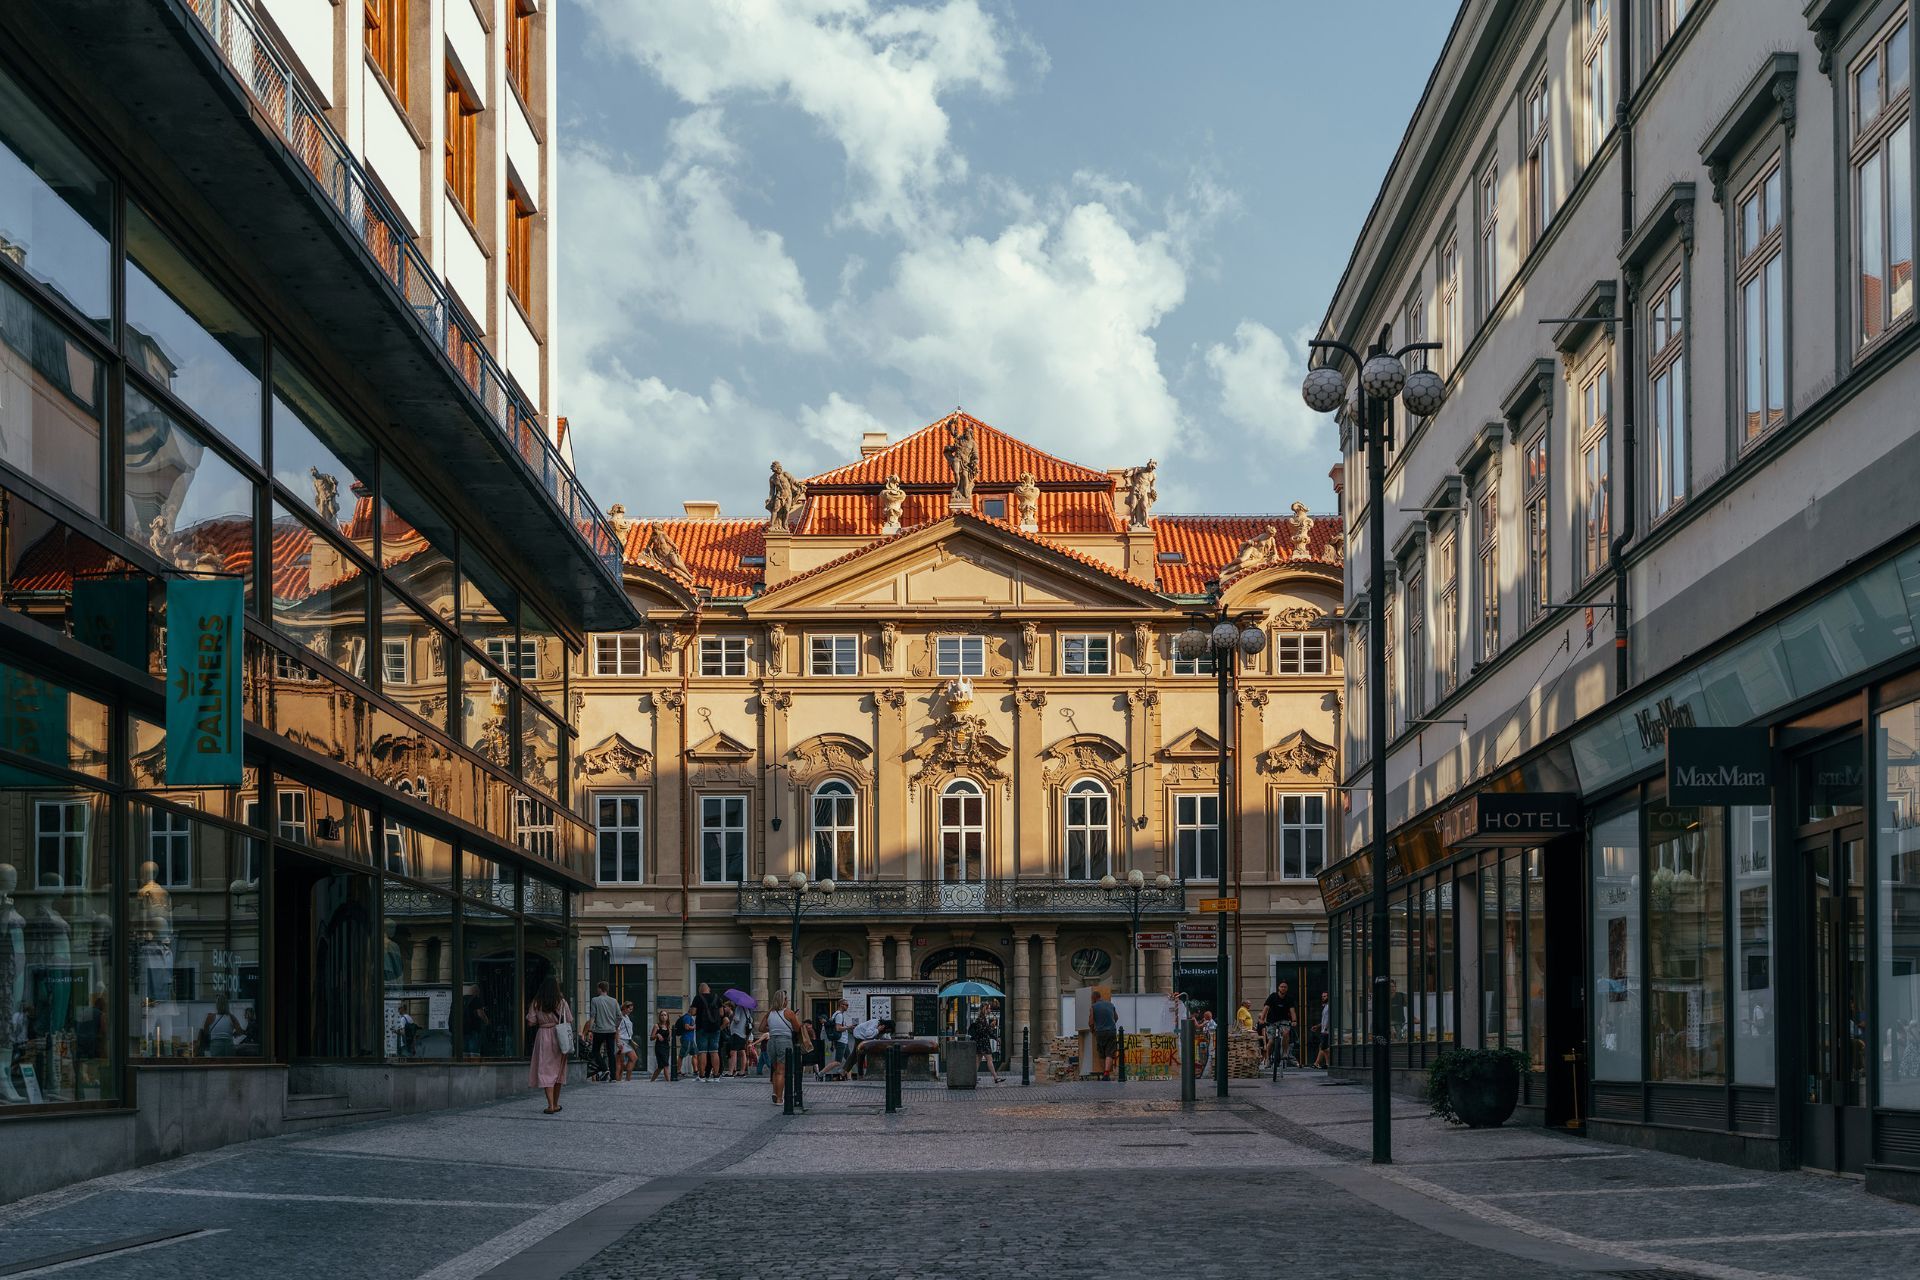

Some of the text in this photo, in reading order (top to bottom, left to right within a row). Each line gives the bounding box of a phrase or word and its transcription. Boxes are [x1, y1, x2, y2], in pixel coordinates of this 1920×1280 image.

[197, 614, 224, 755] PALMERS
[1676, 766, 1765, 787] MaxMara
[1485, 812, 1571, 829] HOTEL
[213, 949, 233, 968] BACK
[212, 973, 242, 993] SCHOOL
[1151, 1048, 1182, 1067] BRICK
